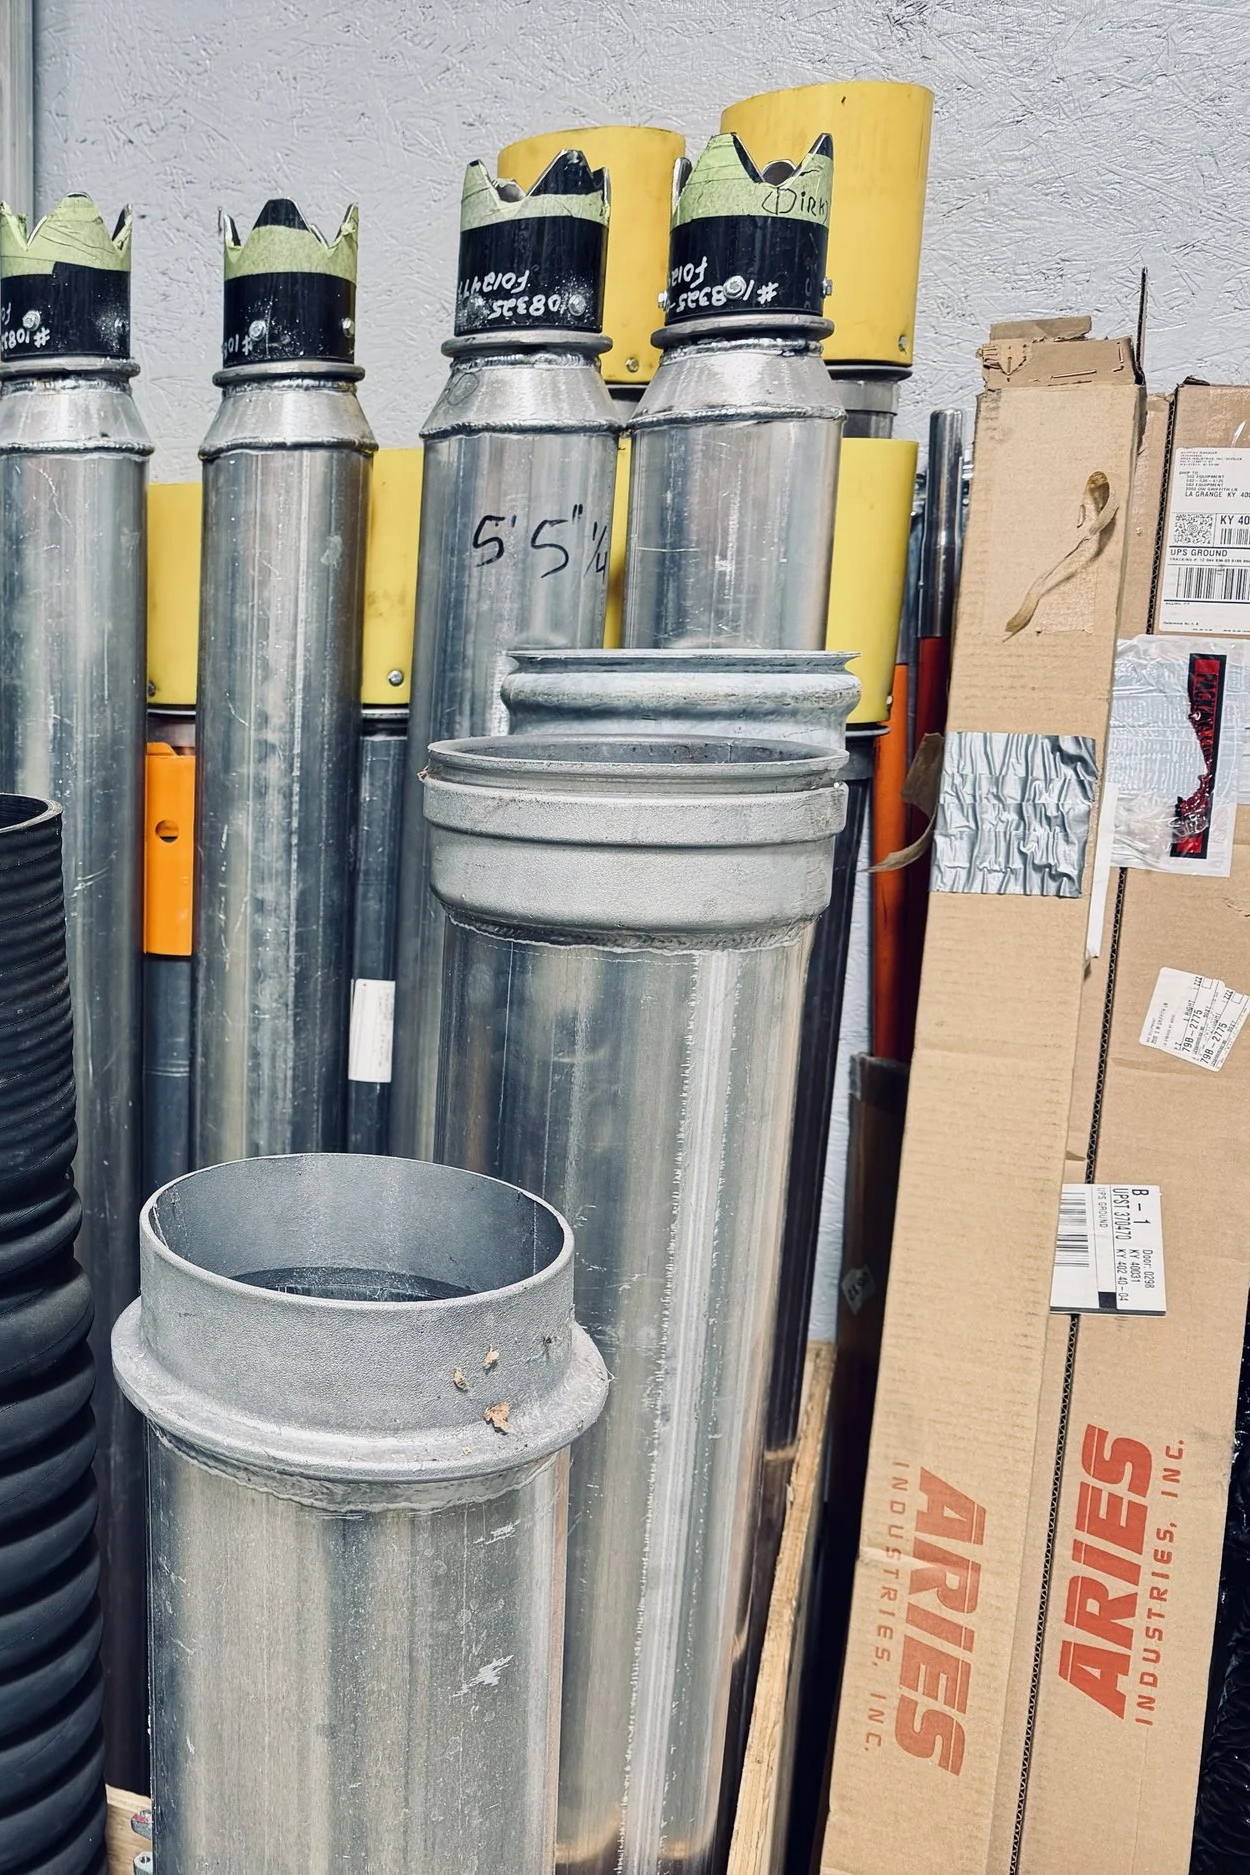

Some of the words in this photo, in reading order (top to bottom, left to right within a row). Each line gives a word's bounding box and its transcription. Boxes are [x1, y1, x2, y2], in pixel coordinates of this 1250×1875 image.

[1220, 515, 1234, 524] KY
[1170, 548, 1188, 556] UPS
[1190, 549, 1228, 557] GROUND
[1097, 1188, 1108, 1200] UPS
[1113, 1188, 1130, 1209] UPST
[1098, 1202, 1109, 1228] GROUND
[1113, 1211, 1132, 1240] 370470
[1116, 1249, 1126, 1259] KY
[1129, 1249, 1140, 1259] KY
[1116, 1261, 1127, 1274] 402
[1130, 1262, 1141, 1283] 40031
[873, 1460, 910, 1668] INDUSTRIES,
[1058, 1423, 1153, 1720] ARIES
[1134, 1521, 1178, 1726] INDUSTRIES,
[1160, 1439, 1185, 1499] INC.
[895, 1466, 987, 1776] ARIES
[864, 1692, 888, 1752] INC.
